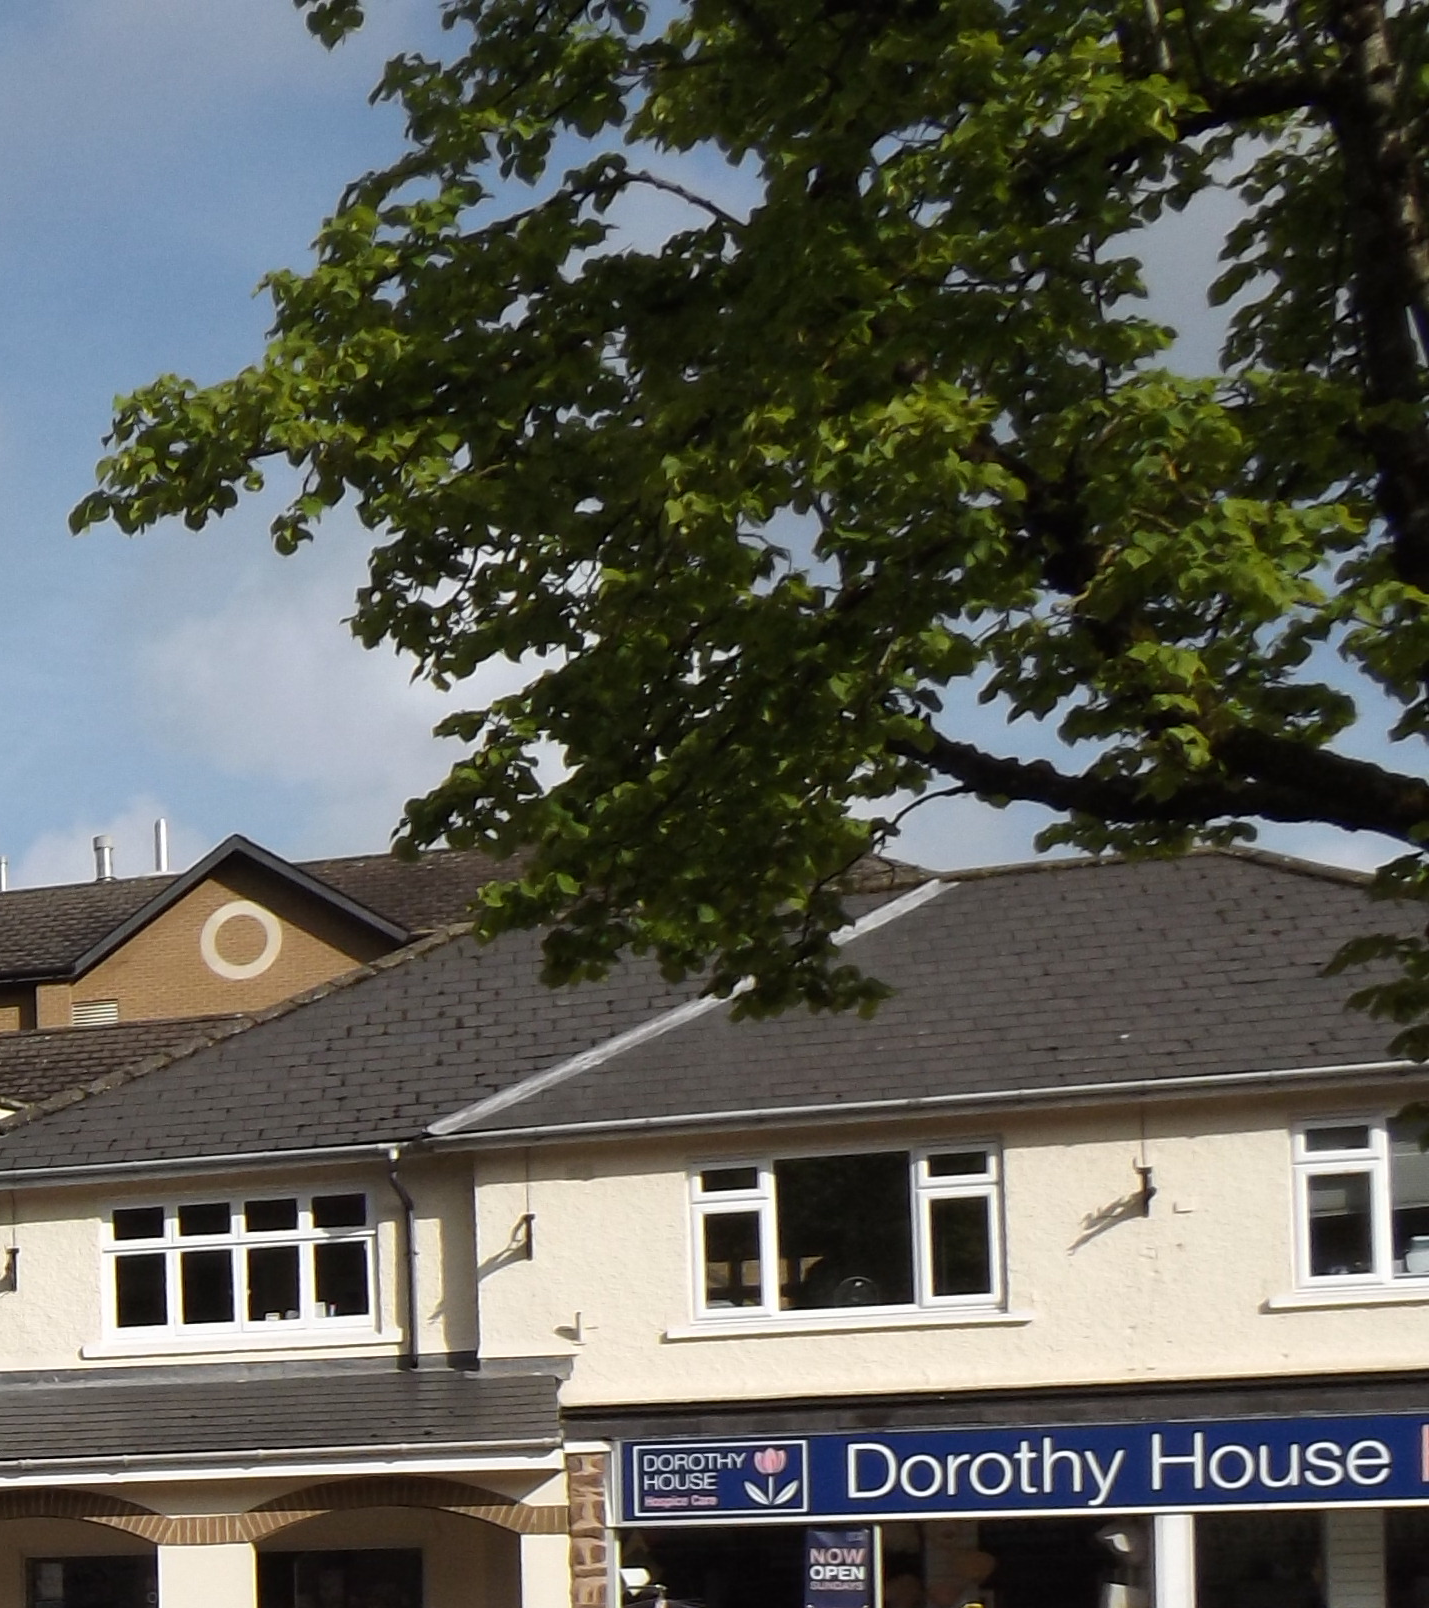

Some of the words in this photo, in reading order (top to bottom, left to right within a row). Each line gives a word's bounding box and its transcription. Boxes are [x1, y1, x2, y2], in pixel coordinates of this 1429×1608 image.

[643, 1452, 747, 1472] DOROTHY
[847, 1437, 1124, 1506] Dorothy
[1150, 1432, 1392, 1491] House
[643, 1472, 718, 1491] HOUSE
[809, 1548, 866, 1565] NOW
[809, 1565, 865, 1581] OPEN
